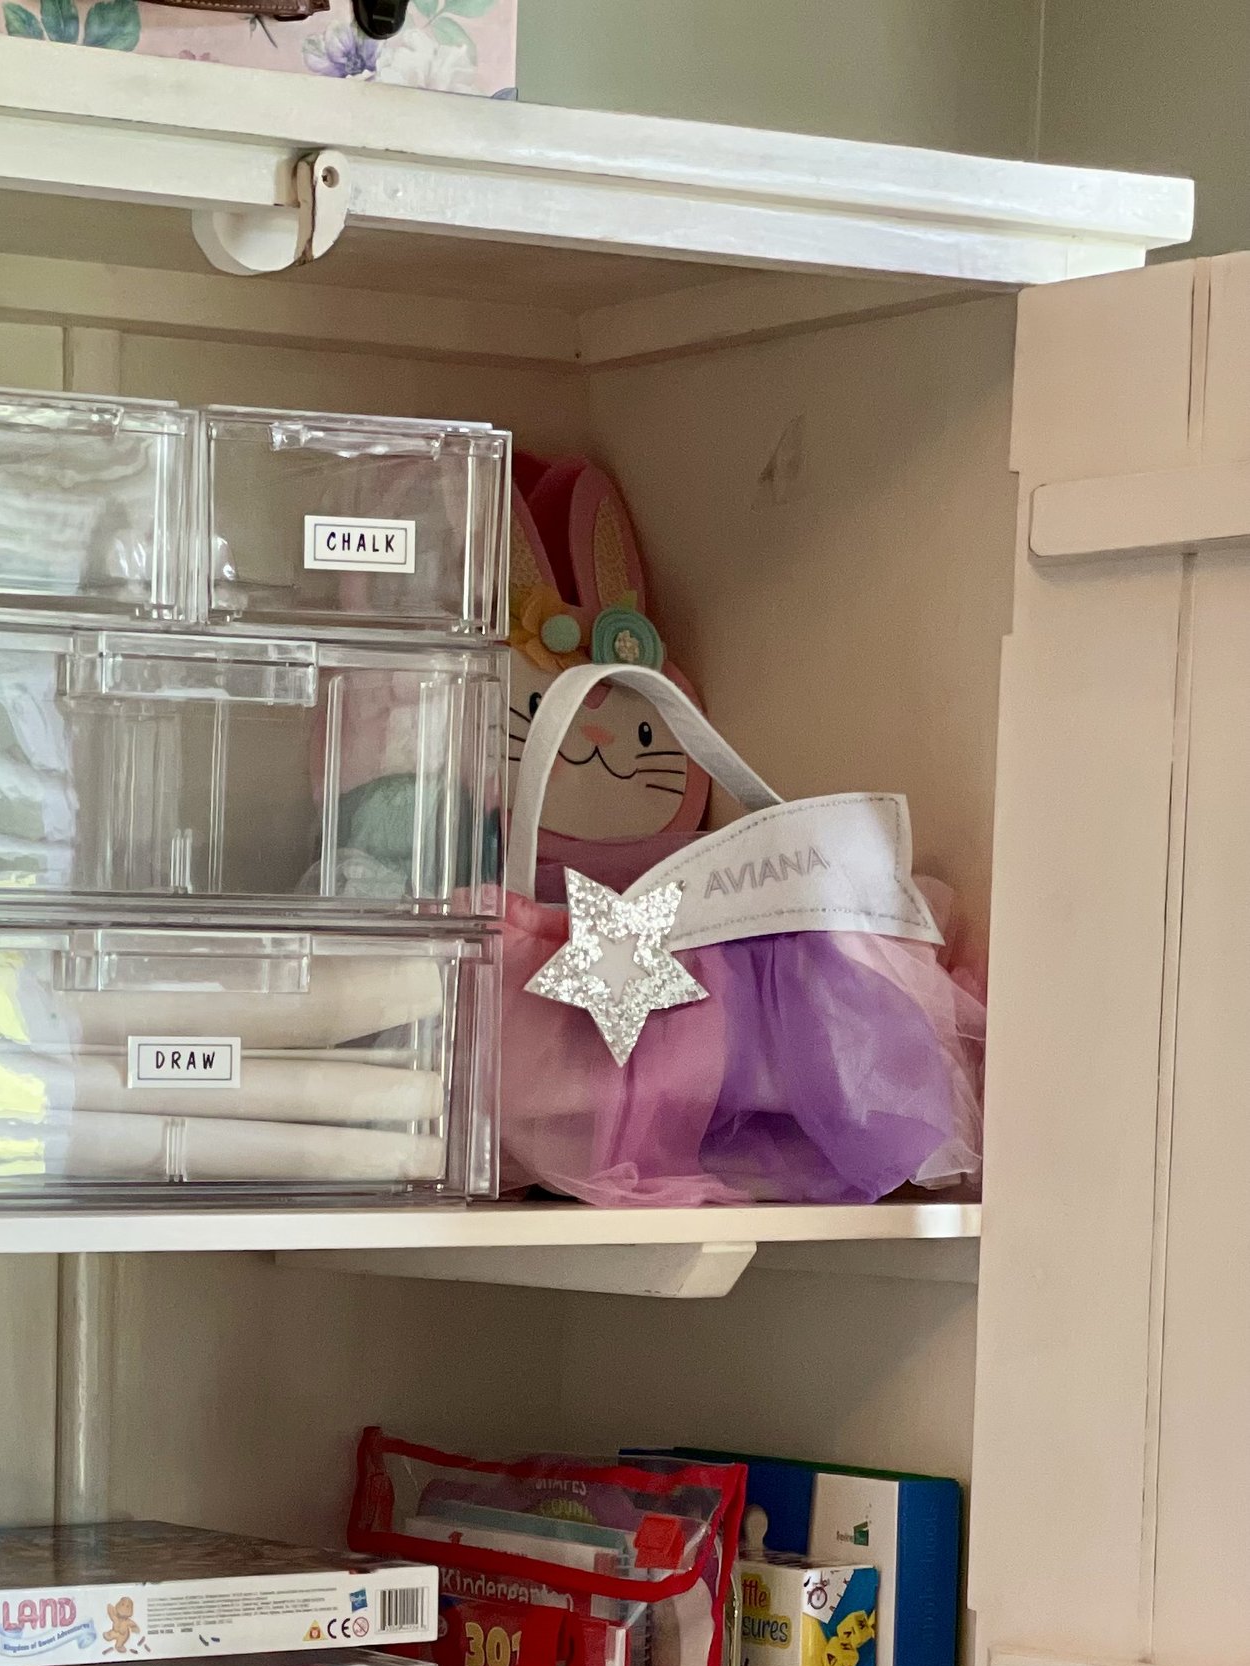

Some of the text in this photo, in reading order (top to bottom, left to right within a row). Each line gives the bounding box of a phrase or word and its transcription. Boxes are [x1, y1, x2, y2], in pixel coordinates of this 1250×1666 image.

[326, 531, 395, 553] CHALK
[704, 847, 831, 899] AVIANA
[155, 1050, 216, 1071] DRAW
[741, 1579, 768, 1608] ttle
[2, 1597, 77, 1632] LAND
[741, 1615, 788, 1643] sures
